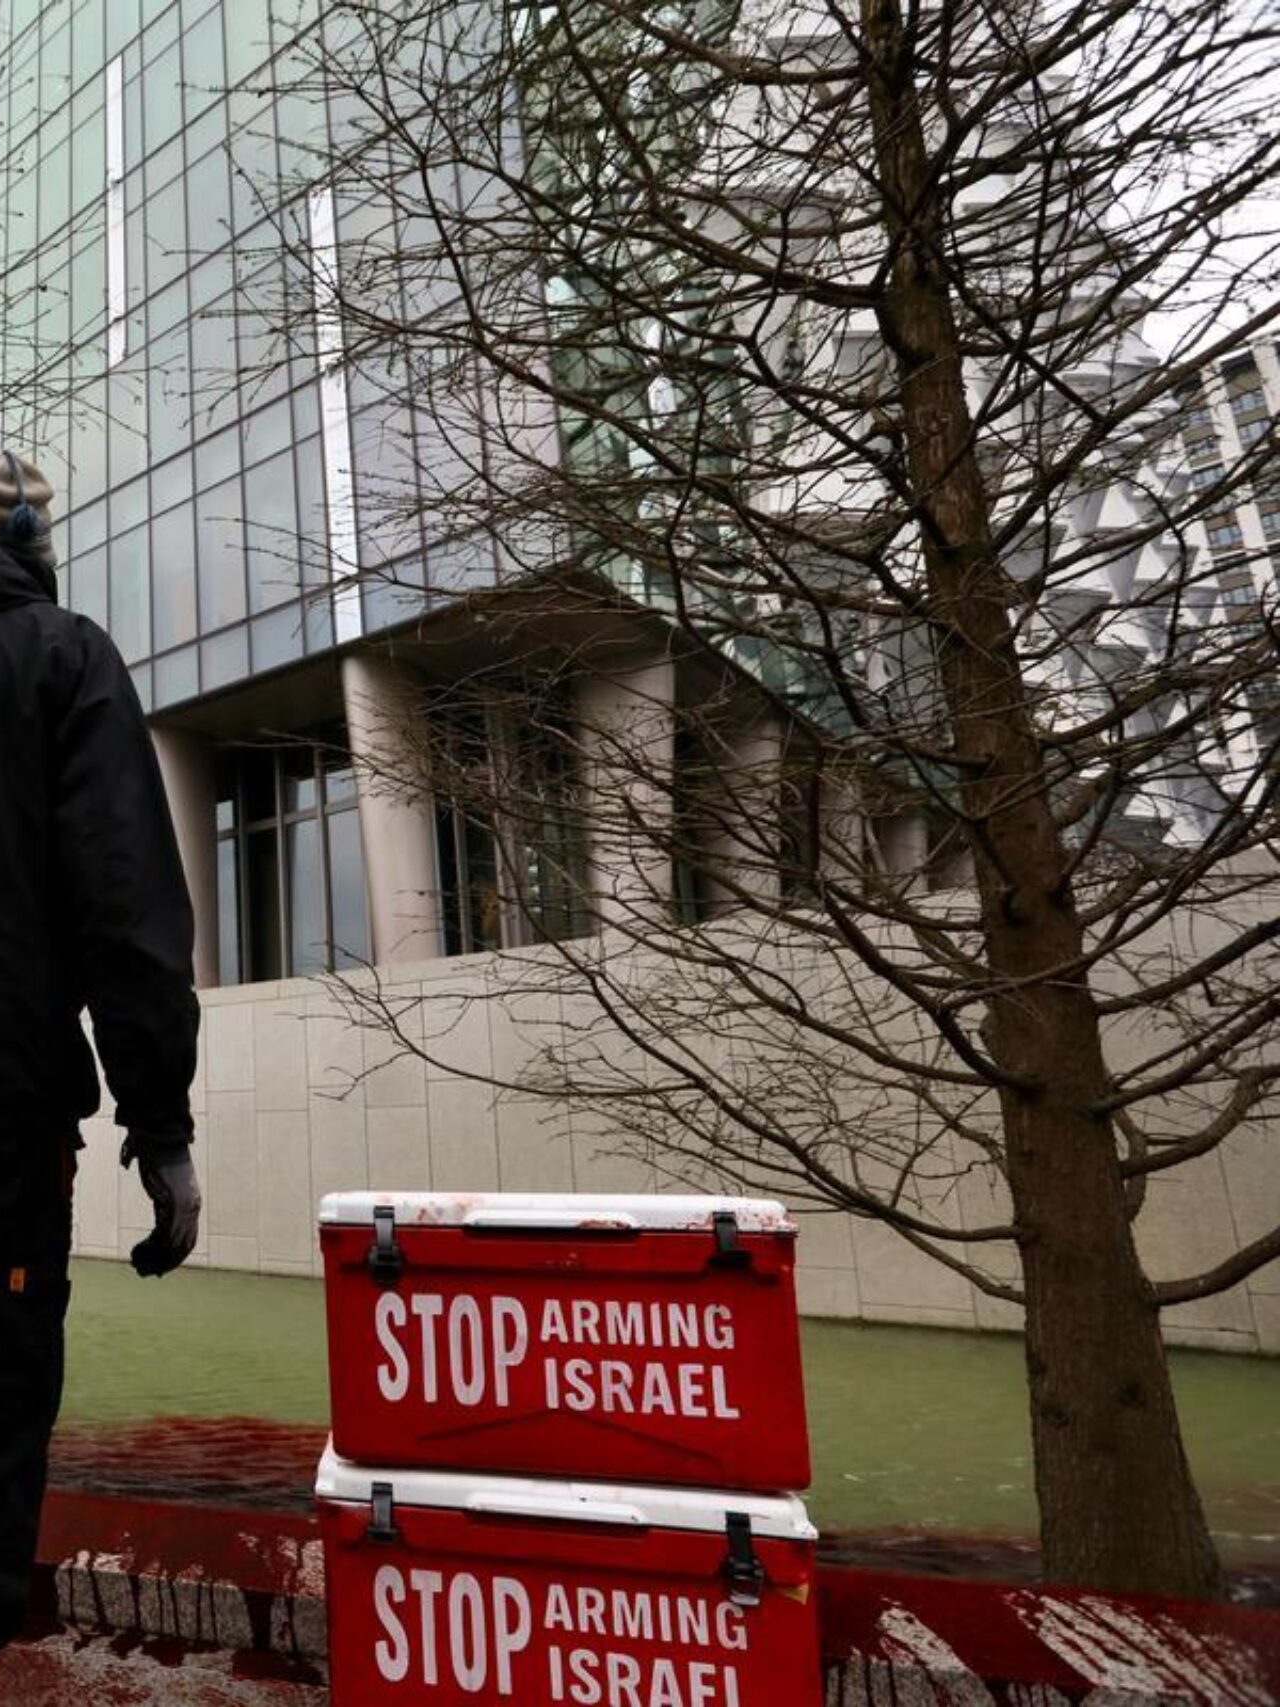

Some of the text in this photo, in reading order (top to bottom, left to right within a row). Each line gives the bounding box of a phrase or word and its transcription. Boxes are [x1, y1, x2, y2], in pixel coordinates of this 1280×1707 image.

[374, 1291, 529, 1407] STOP
[540, 1298, 735, 1350] ARMING
[544, 1357, 740, 1419] ISRAEL
[373, 1564, 532, 1695] STOP
[543, 1583, 748, 1651] ARMING
